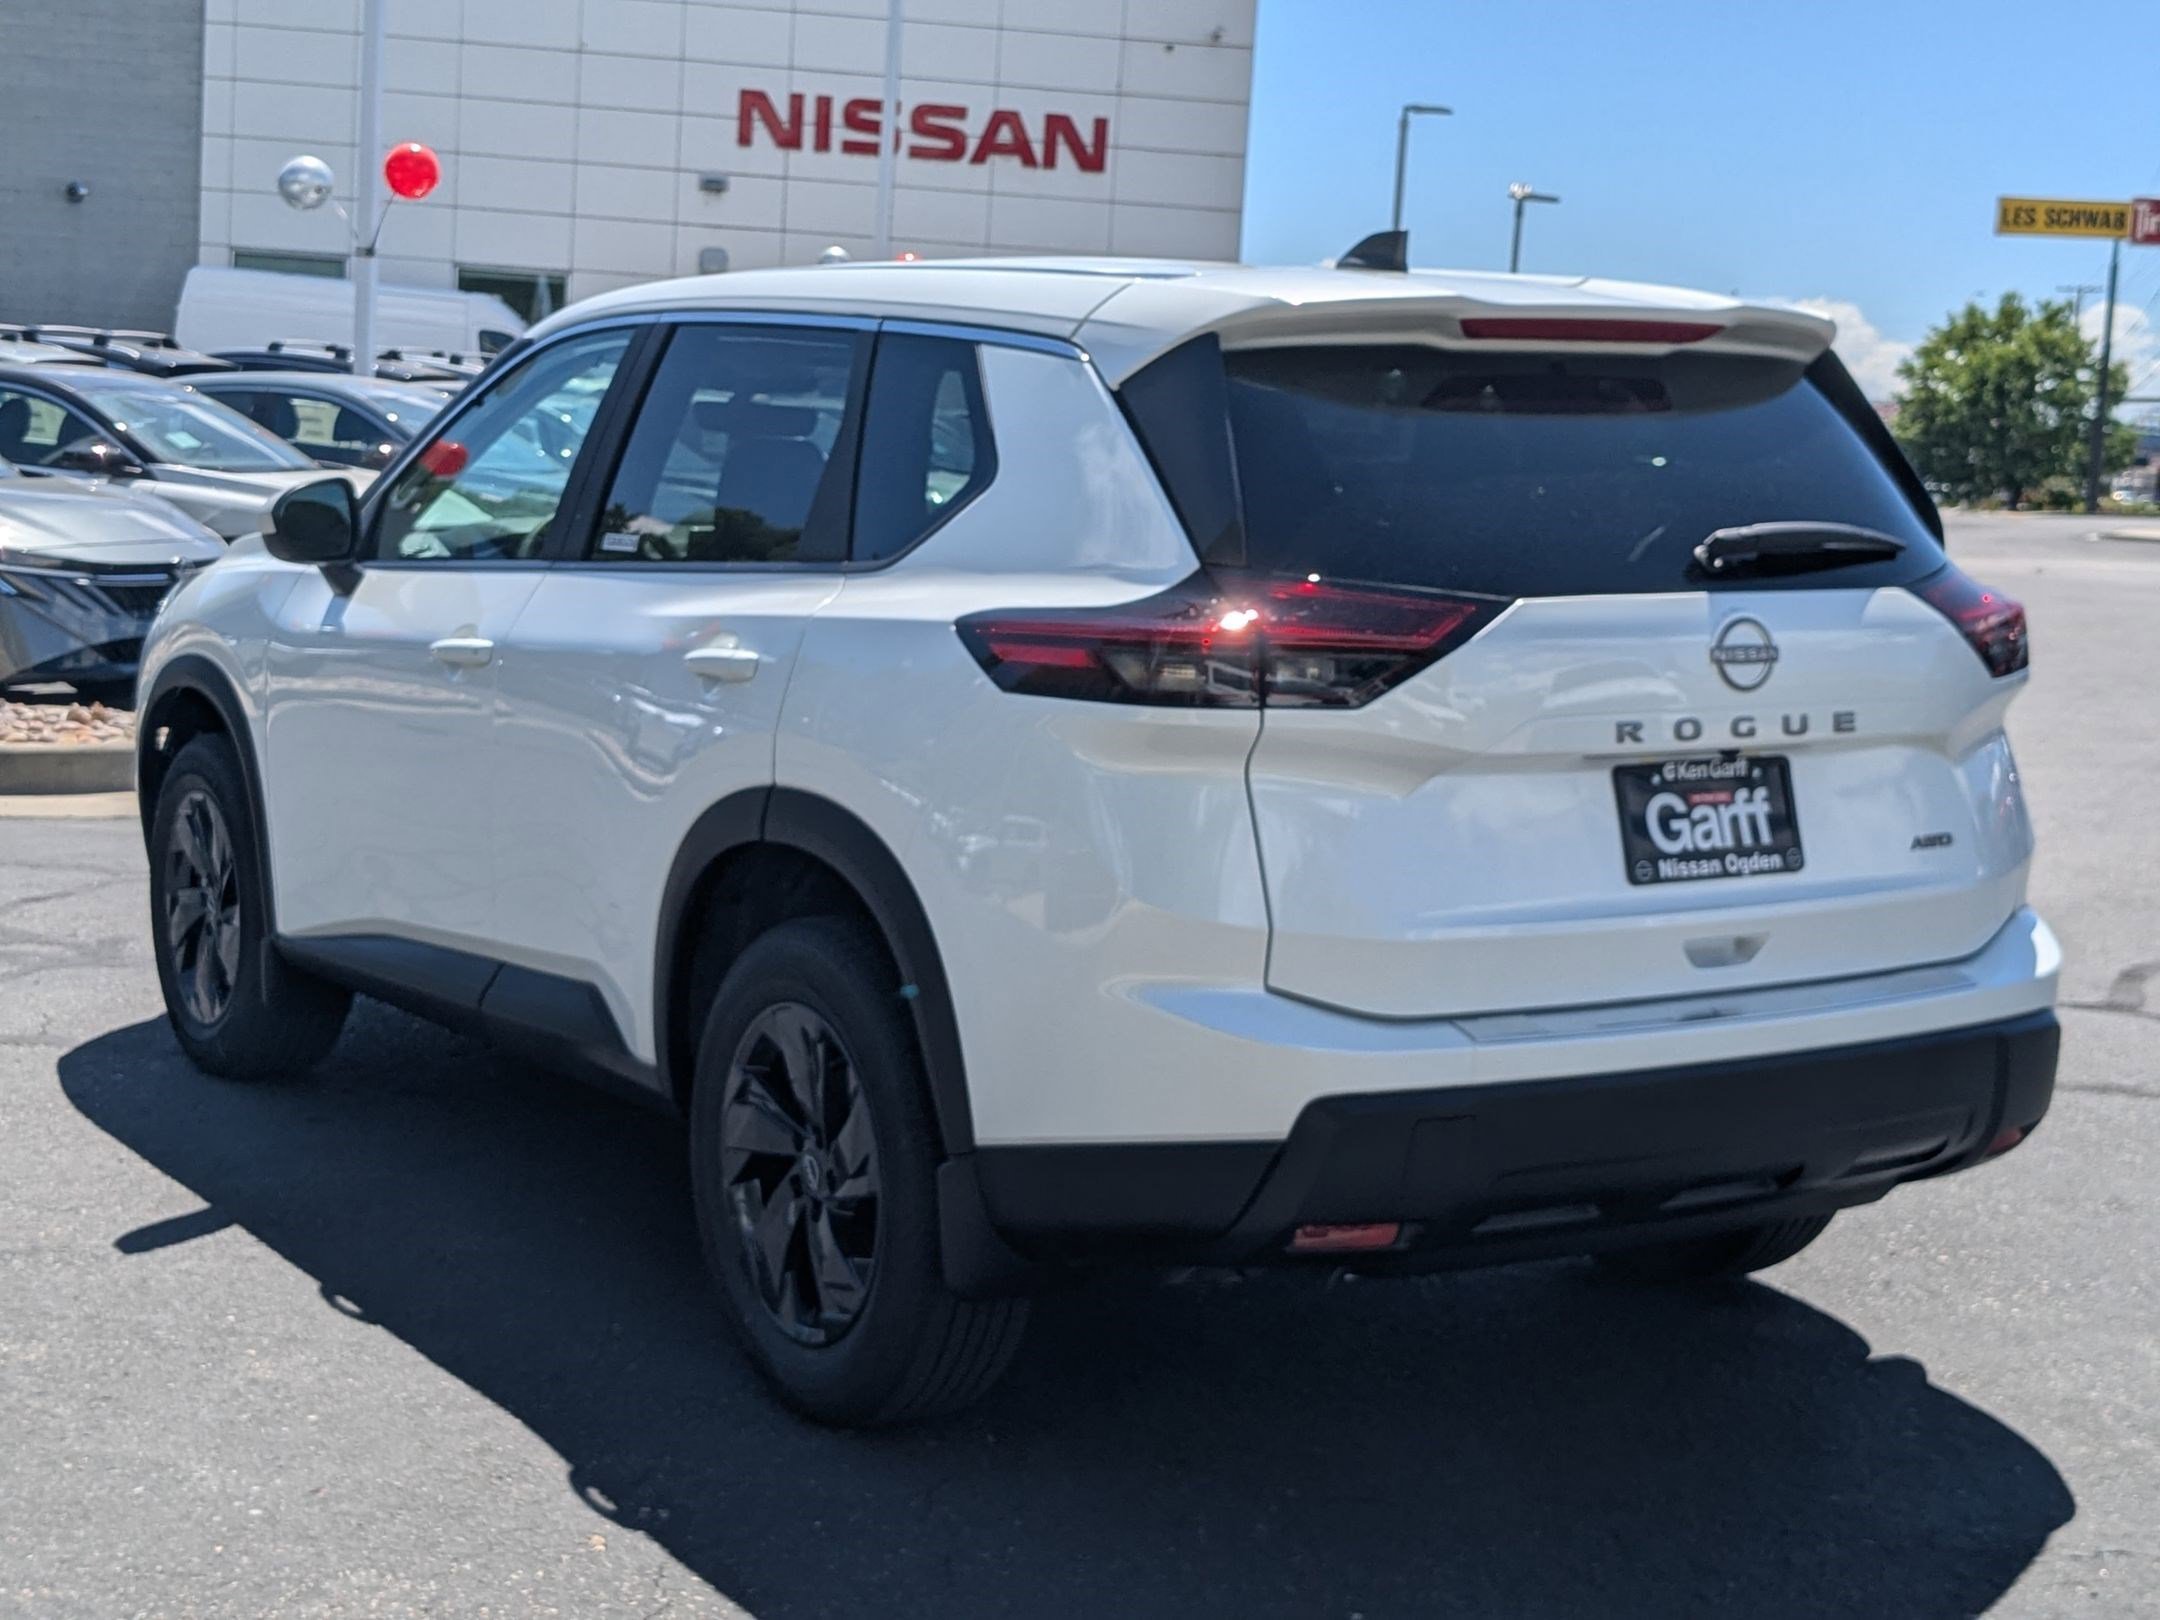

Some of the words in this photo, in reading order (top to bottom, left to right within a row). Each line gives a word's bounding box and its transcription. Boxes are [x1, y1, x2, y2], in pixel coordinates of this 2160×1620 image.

[737, 88, 1108, 173] NISSAN
[2002, 207, 2036, 226] LES
[2045, 209, 2125, 230] SCHWAB
[1616, 711, 1856, 743] ROGUE
[1678, 761, 1709, 780] Ken
[1646, 787, 1772, 854] Garff
[1658, 858, 1723, 879] Nissan
[1725, 852, 1783, 874] Ogden
